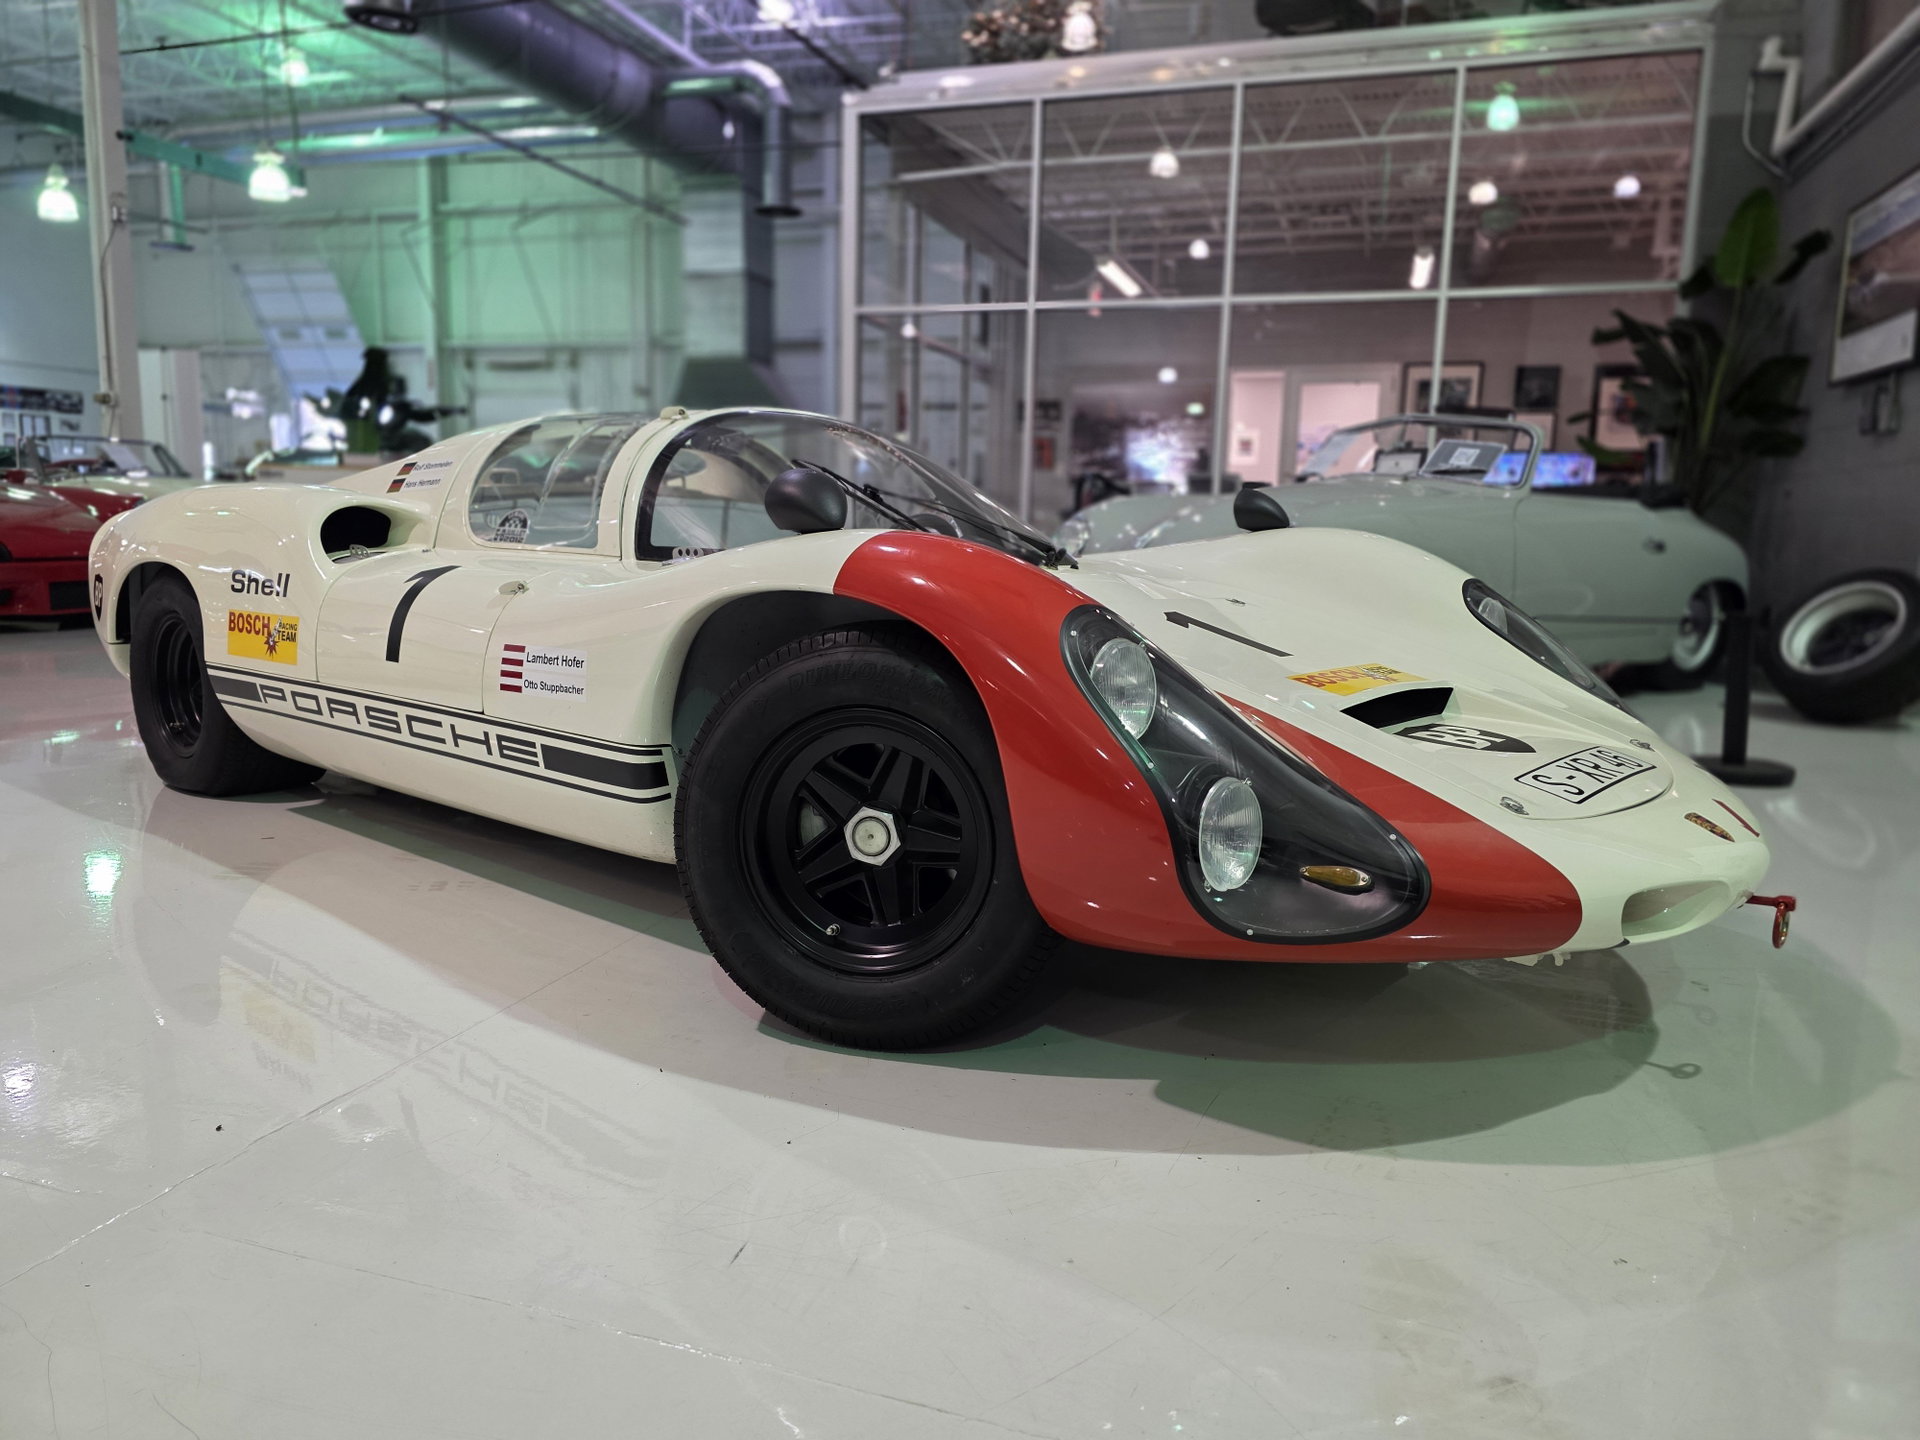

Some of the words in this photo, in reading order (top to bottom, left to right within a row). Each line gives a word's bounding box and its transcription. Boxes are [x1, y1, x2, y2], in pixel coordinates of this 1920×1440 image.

[230, 569, 290, 598] Shell
[228, 611, 271, 637] BOSCH
[386, 565, 462, 663] 1
[277, 629, 297, 643] TEAM
[278, 621, 298, 631] RACING
[526, 651, 559, 666] Lambert
[561, 655, 585, 668] Hofer
[523, 679, 538, 690] Otto
[539, 680, 585, 695] Stuppbacher
[1292, 668, 1366, 688] BOSCH
[259, 683, 540, 768] PORSCHE
[1407, 725, 1506, 750] BP
